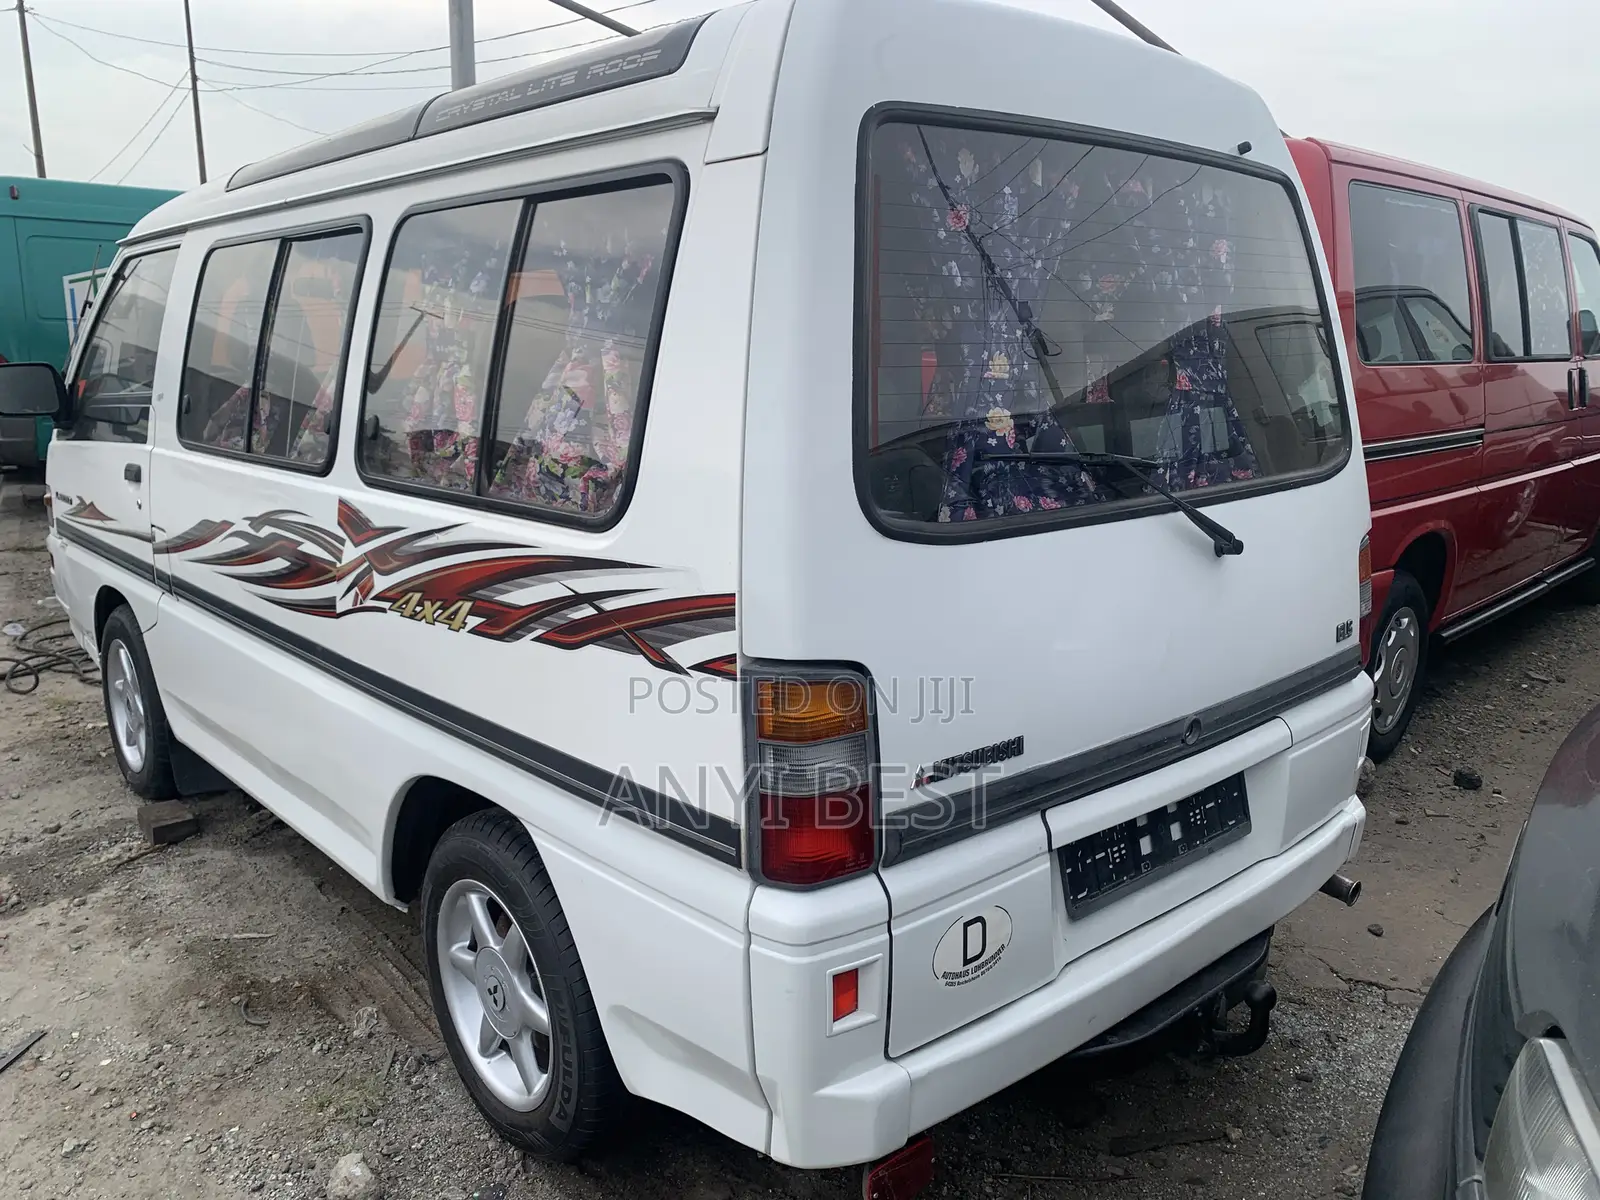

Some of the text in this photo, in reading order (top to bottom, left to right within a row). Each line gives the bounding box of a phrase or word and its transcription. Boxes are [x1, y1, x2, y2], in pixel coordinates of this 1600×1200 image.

[436, 49, 662, 122] CRYSTAL LITE ROOF
[931, 735, 1025, 783] MITSUBISHI
[962, 915, 987, 967] D
[941, 969, 970, 981] AUTOHAUS
